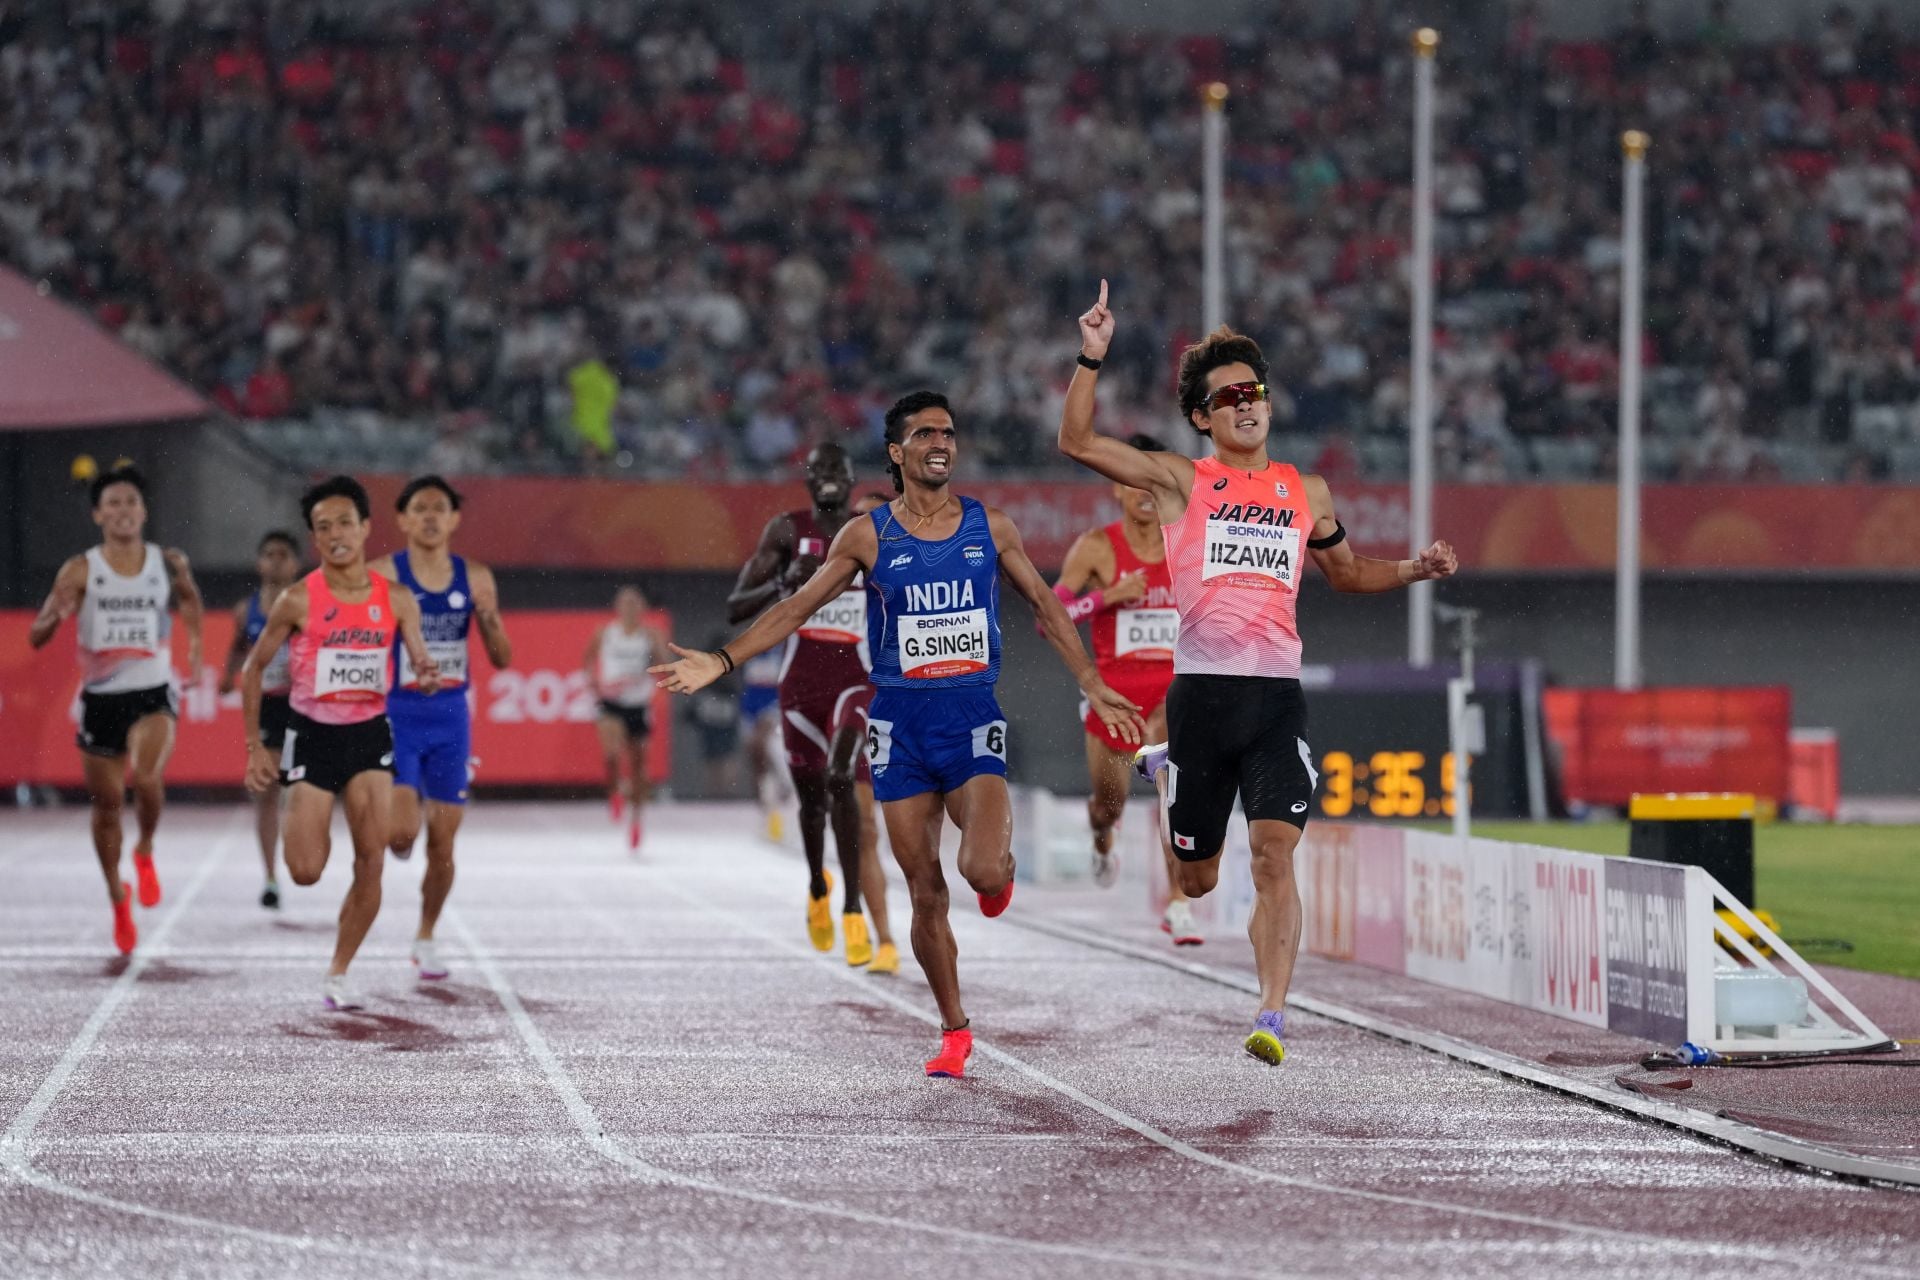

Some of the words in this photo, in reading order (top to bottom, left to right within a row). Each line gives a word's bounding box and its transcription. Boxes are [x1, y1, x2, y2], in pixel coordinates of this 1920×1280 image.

[1209, 503, 1294, 528] JAPAN
[1227, 526, 1283, 540] BORNAN
[888, 555, 913, 569] JSW
[1211, 542, 1290, 571] IIZAWA
[1276, 571, 1290, 580] 386
[98, 597, 156, 611] KOREA
[905, 579, 975, 612] INDIA
[1123, 587, 1175, 609] CHIN
[812, 610, 861, 626] HUOT
[916, 615, 971, 629] BORNAN
[323, 629, 385, 647] JAPAN
[1129, 626, 1177, 643] D.LIU
[905, 631, 984, 658] G.SINGH
[969, 651, 985, 660] 322
[329, 667, 381, 685] MORI
[489, 668, 599, 723] 202
[986, 726, 1003, 754] 6
[1536, 860, 1602, 1015] TOYOTA
